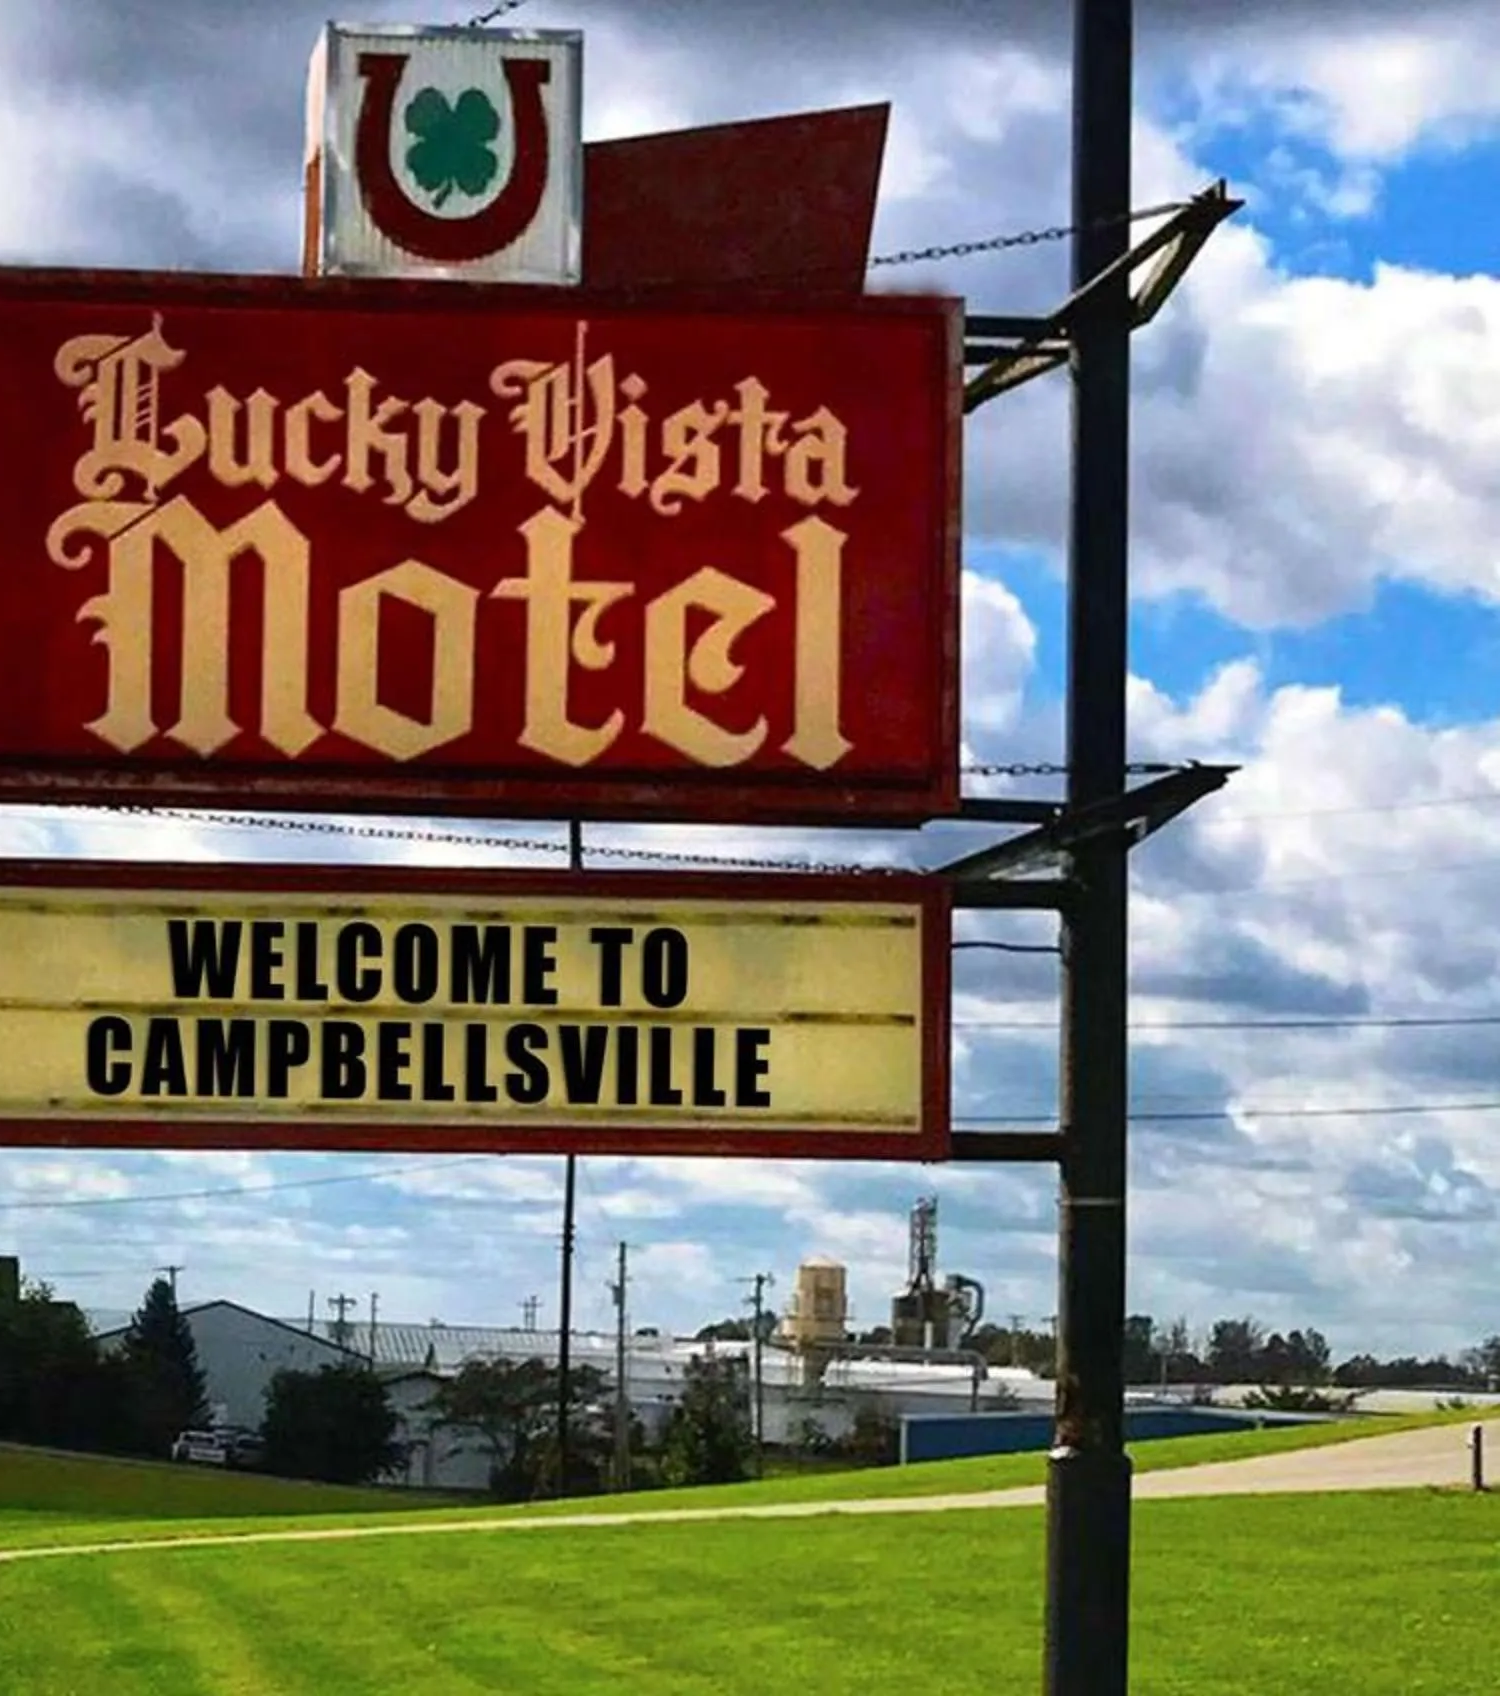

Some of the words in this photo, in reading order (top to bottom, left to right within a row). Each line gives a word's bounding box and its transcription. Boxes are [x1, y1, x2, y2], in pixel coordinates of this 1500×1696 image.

[55, 312, 487, 523] Lucky
[490, 320, 861, 518] Vista
[46, 494, 855, 771] Motel
[167, 919, 559, 1005] WELCOME
[590, 927, 689, 1009] TO
[86, 1015, 772, 1108] CAMPBELLSVILLE
